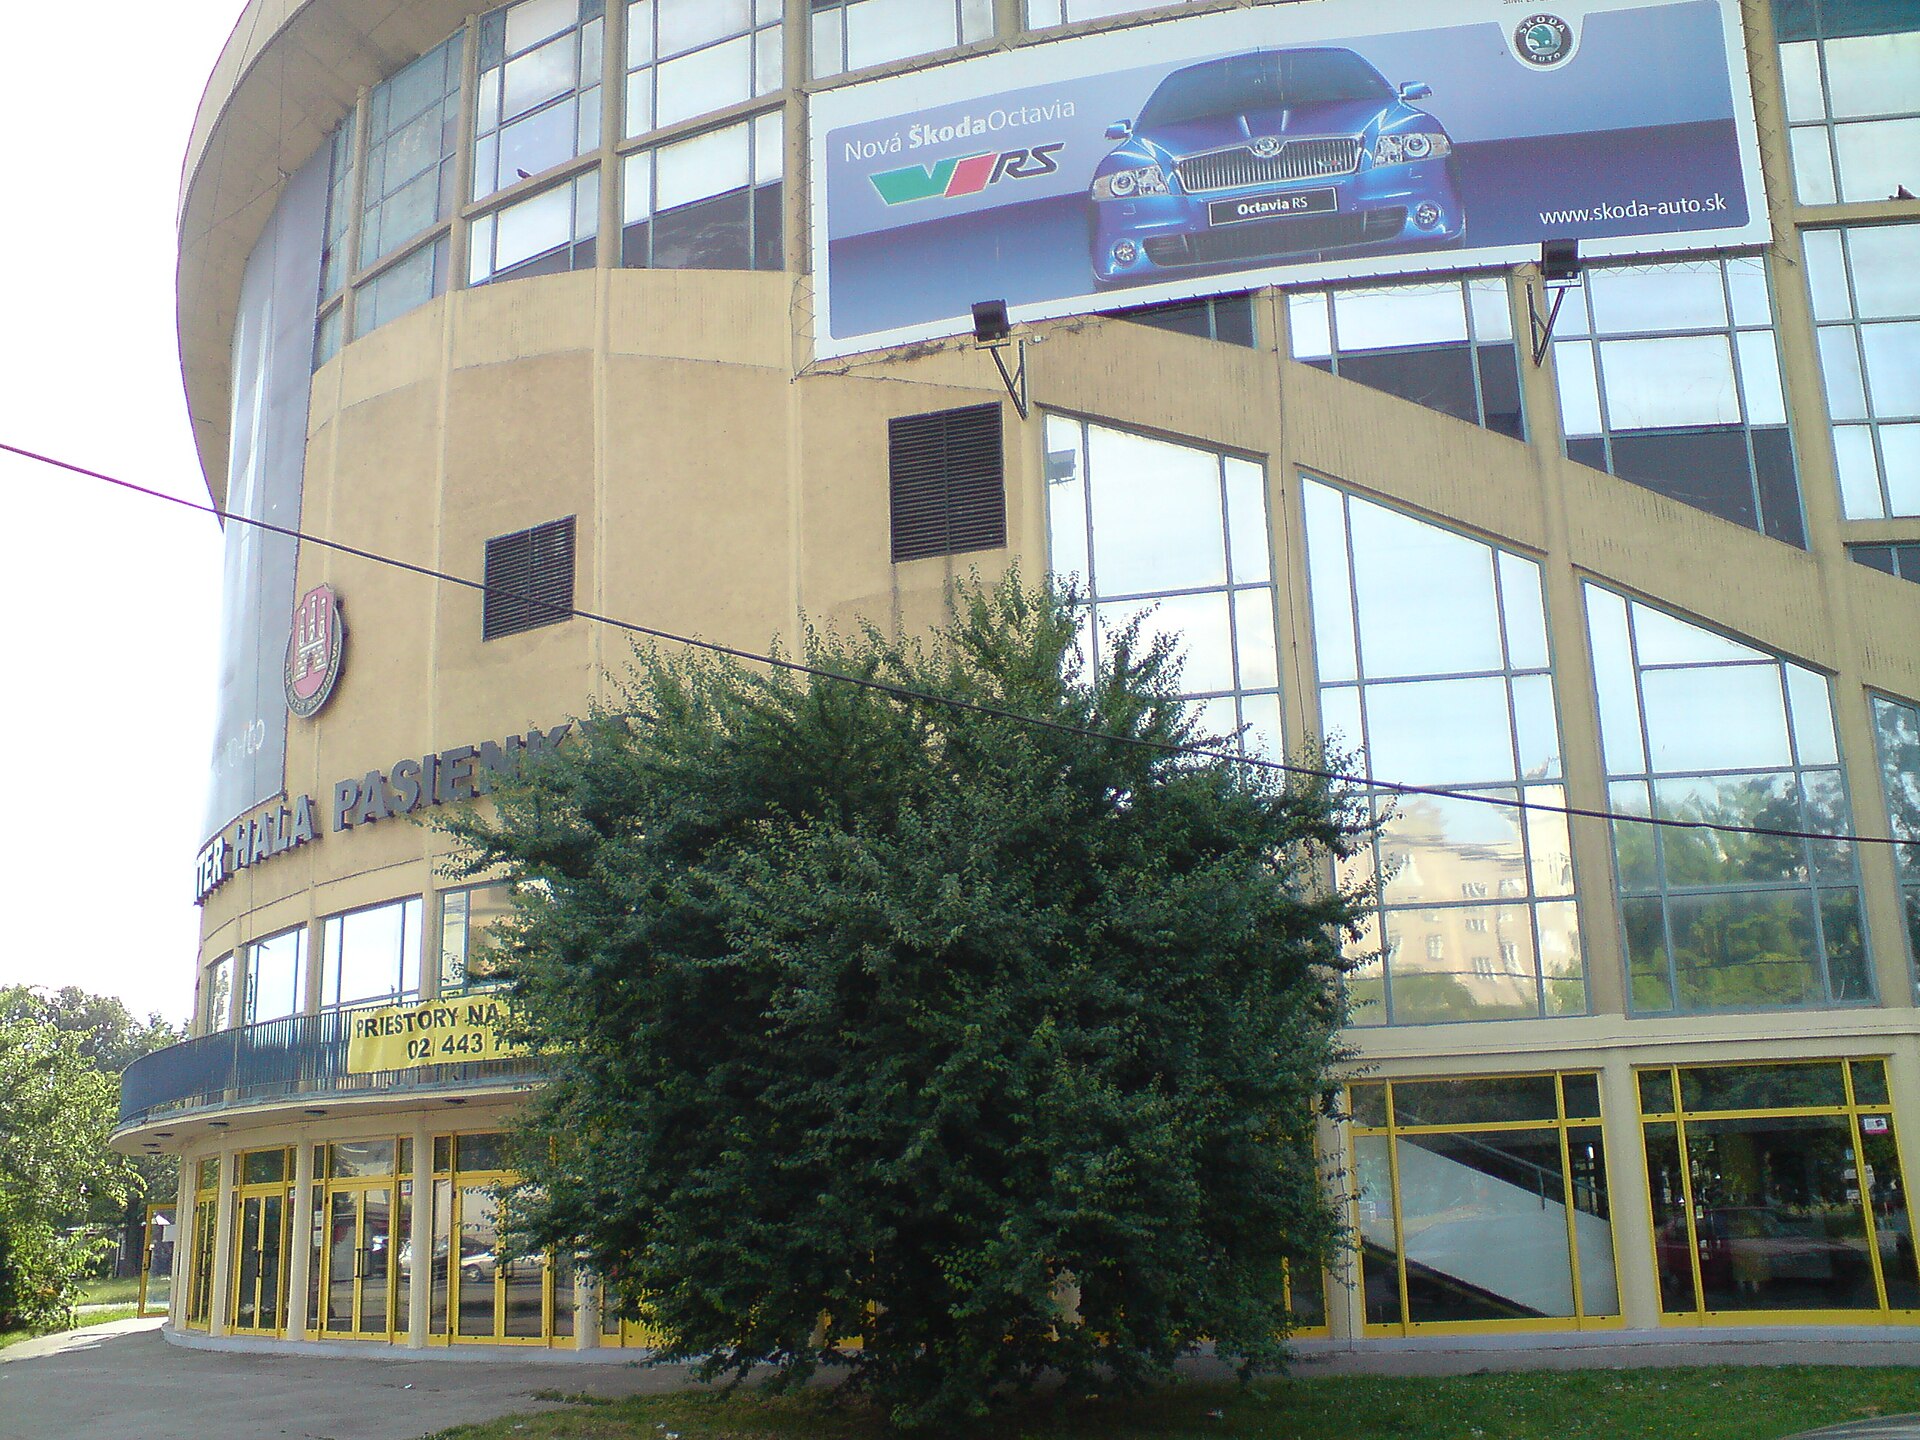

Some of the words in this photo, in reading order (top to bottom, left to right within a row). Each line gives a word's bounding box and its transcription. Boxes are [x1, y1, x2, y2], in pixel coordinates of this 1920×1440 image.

[1531, 52, 1561, 62] AUTO
[845, 132, 902, 162] Nová
[1237, 199, 1290, 215] Octavia
[1292, 196, 1308, 209] RS
[1539, 192, 1727, 225] www.skoda-auto.sk
[231, 794, 312, 871] HALA
[356, 1007, 459, 1039] PRIESTORY
[467, 1003, 499, 1027] NA
[407, 1036, 437, 1060] 02/
[441, 1032, 484, 1055] 443
